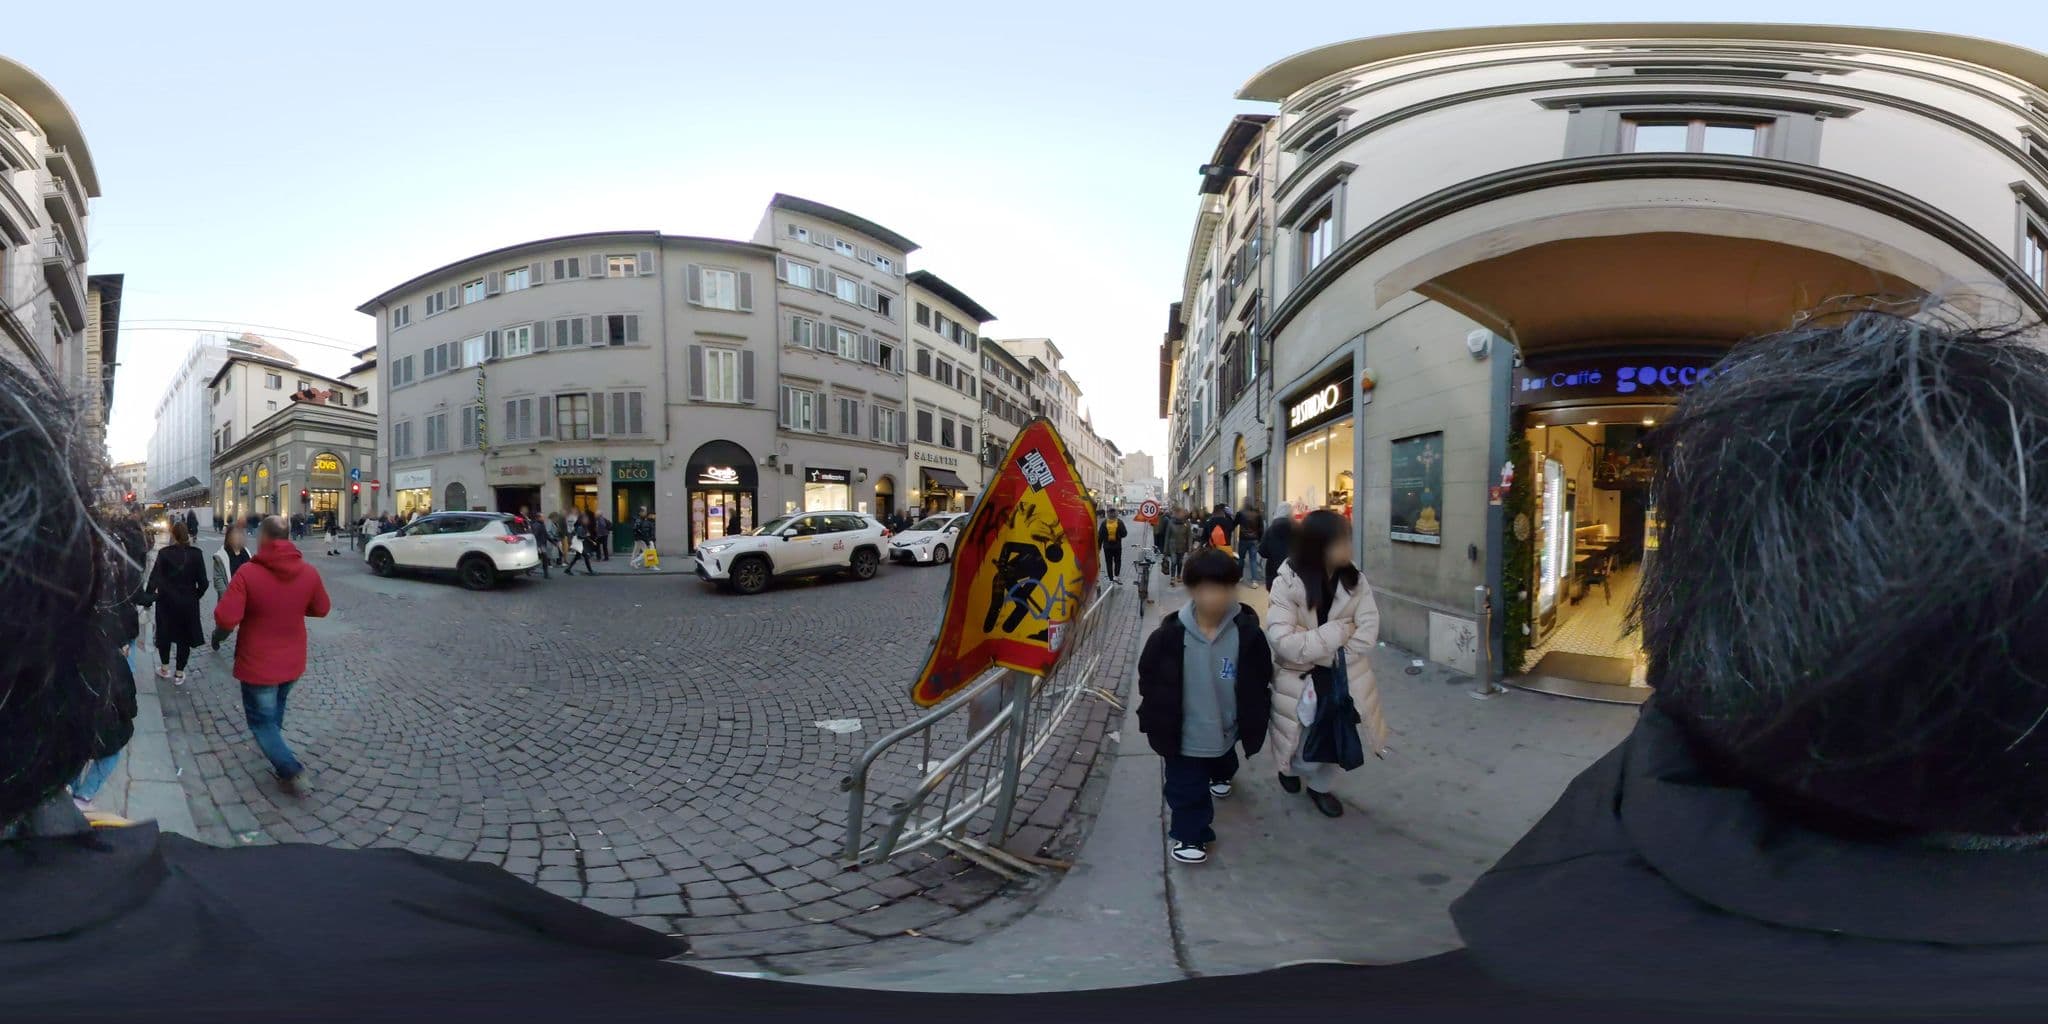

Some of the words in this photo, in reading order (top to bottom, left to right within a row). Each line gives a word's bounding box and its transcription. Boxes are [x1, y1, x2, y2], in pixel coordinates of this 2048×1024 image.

[1521, 378, 1547, 391] Bar
[553, 456, 591, 466] HOTEL
[914, 451, 958, 466] SABATINI
[619, 469, 648, 479] DECO
[1144, 505, 1155, 514] 30
